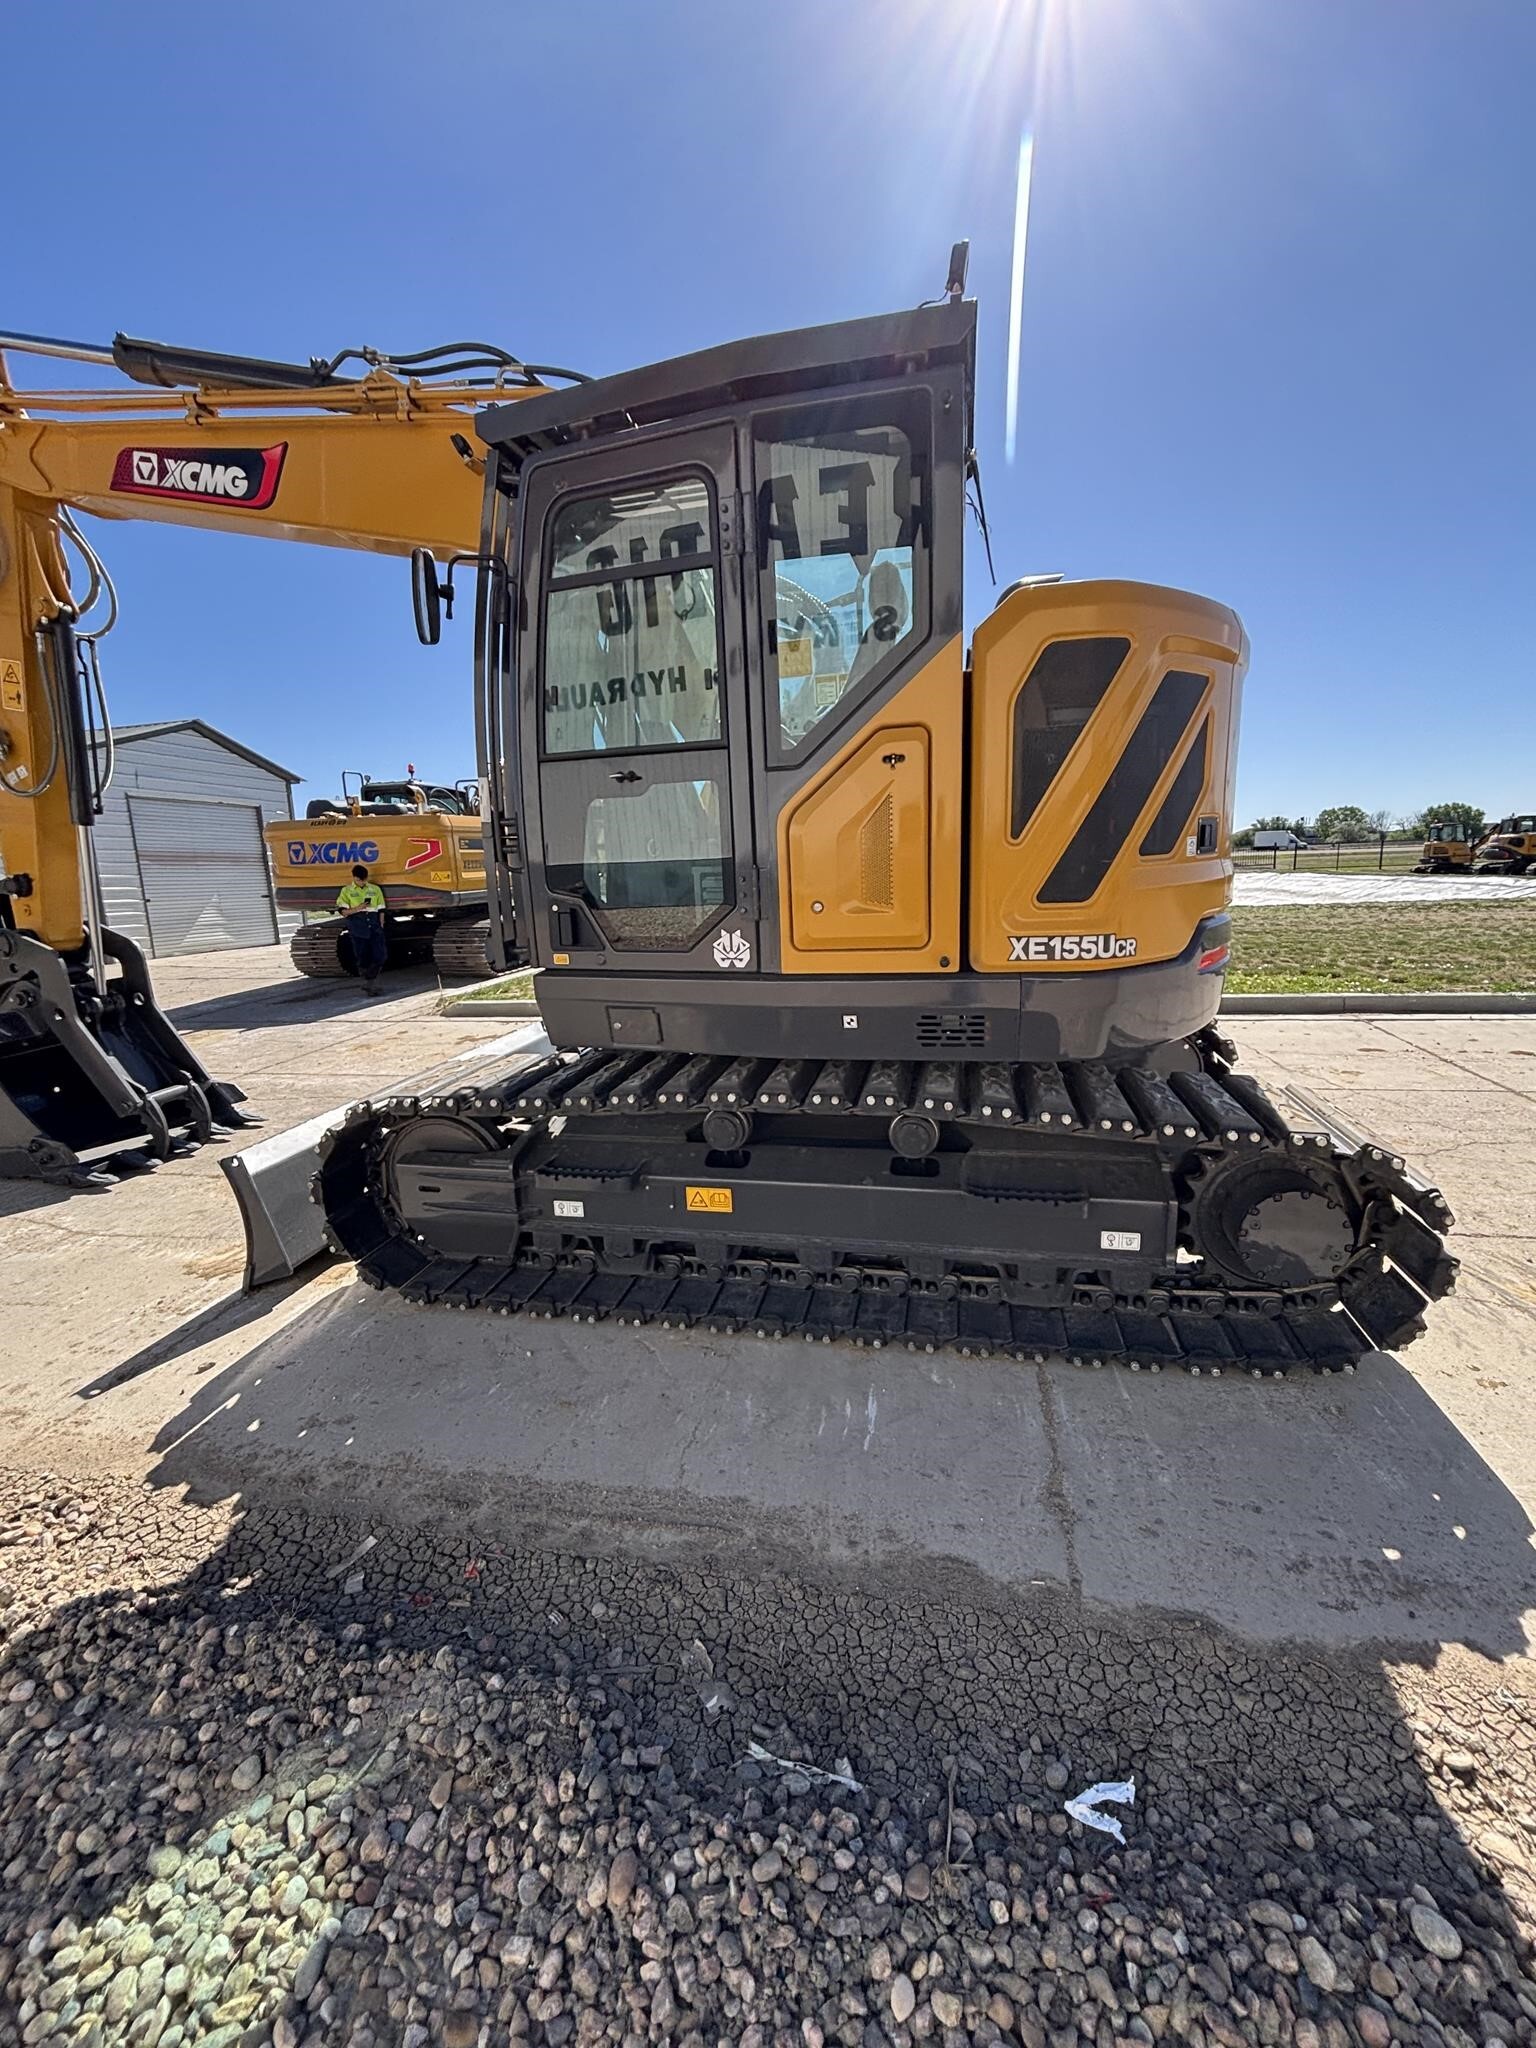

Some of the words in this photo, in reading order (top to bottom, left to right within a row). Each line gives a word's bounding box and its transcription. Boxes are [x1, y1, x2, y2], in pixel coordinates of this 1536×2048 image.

[159, 458, 248, 497] XCMG
[307, 840, 380, 864] XCMG
[1008, 934, 1137, 961] XE155UCR
